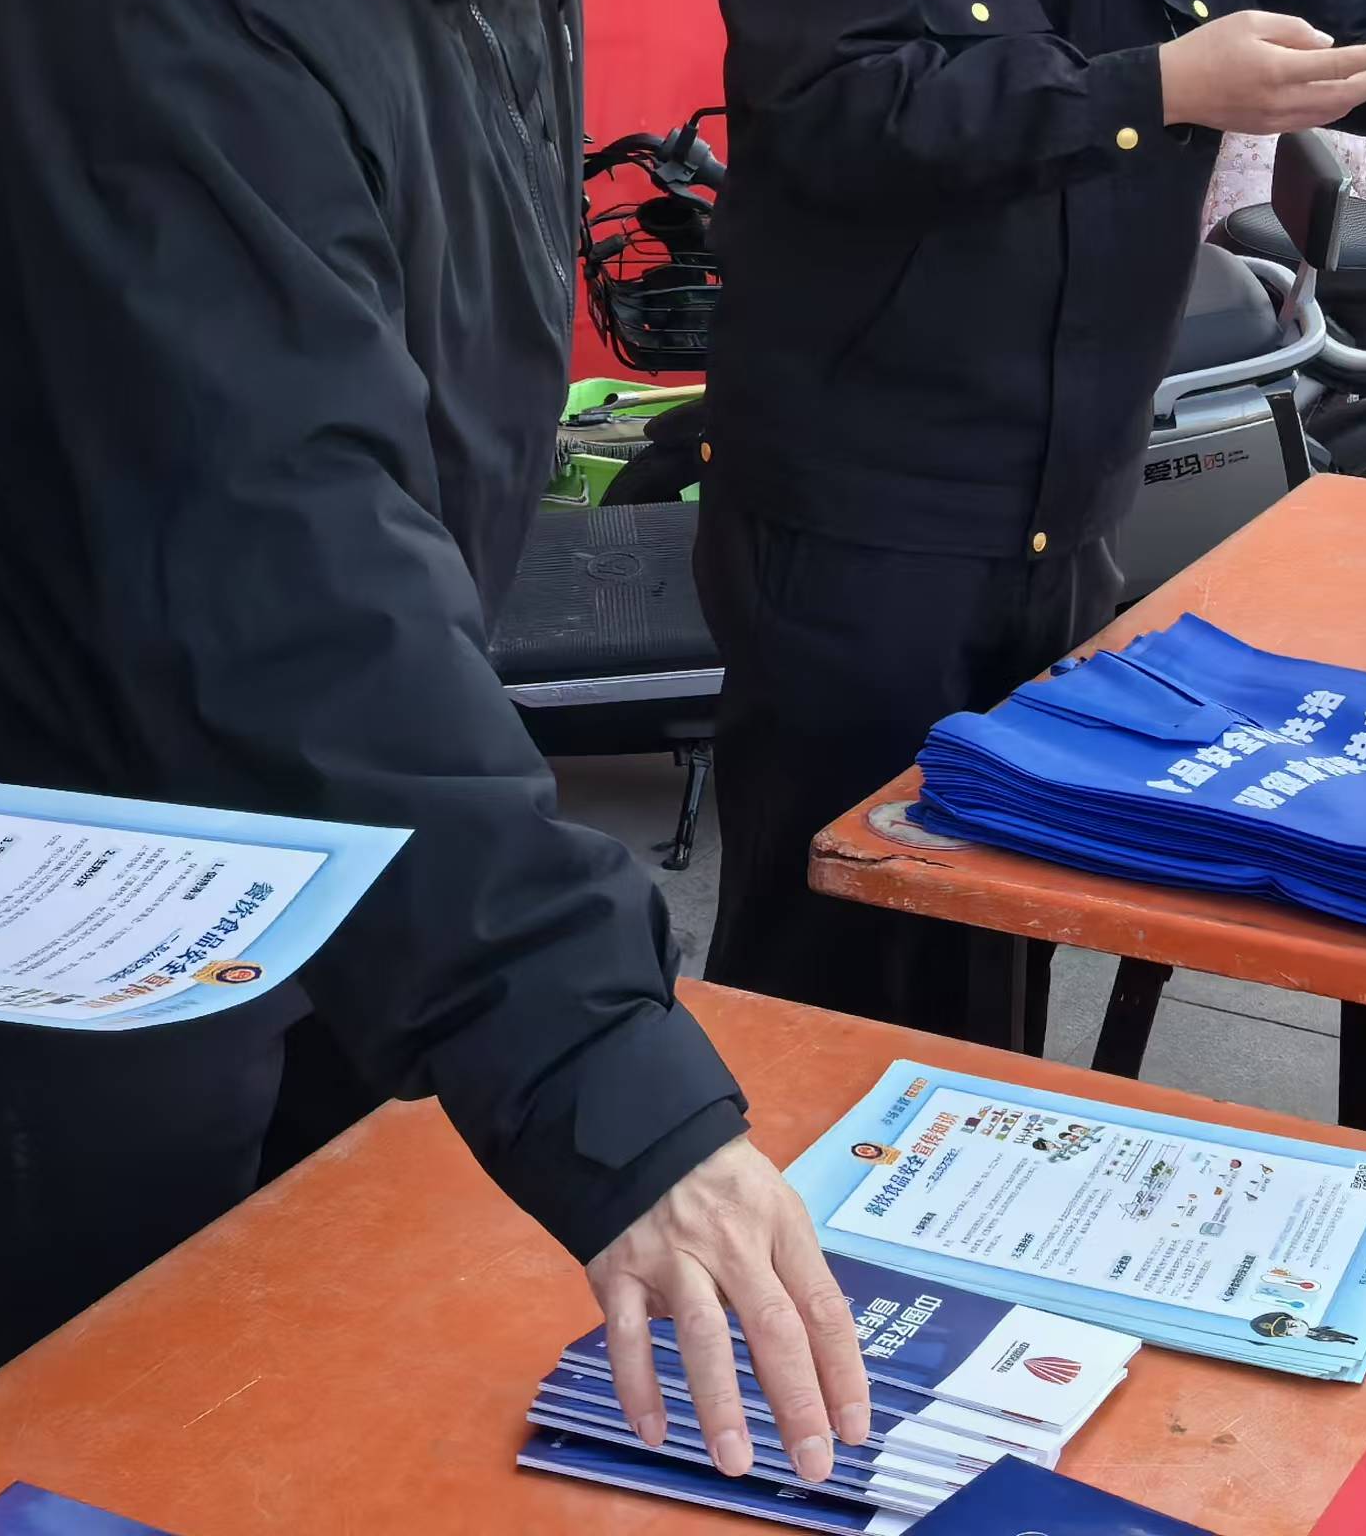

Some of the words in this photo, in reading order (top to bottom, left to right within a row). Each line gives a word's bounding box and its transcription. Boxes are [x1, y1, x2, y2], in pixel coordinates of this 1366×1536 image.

[861, 1294, 944, 1361] 中国反走私
